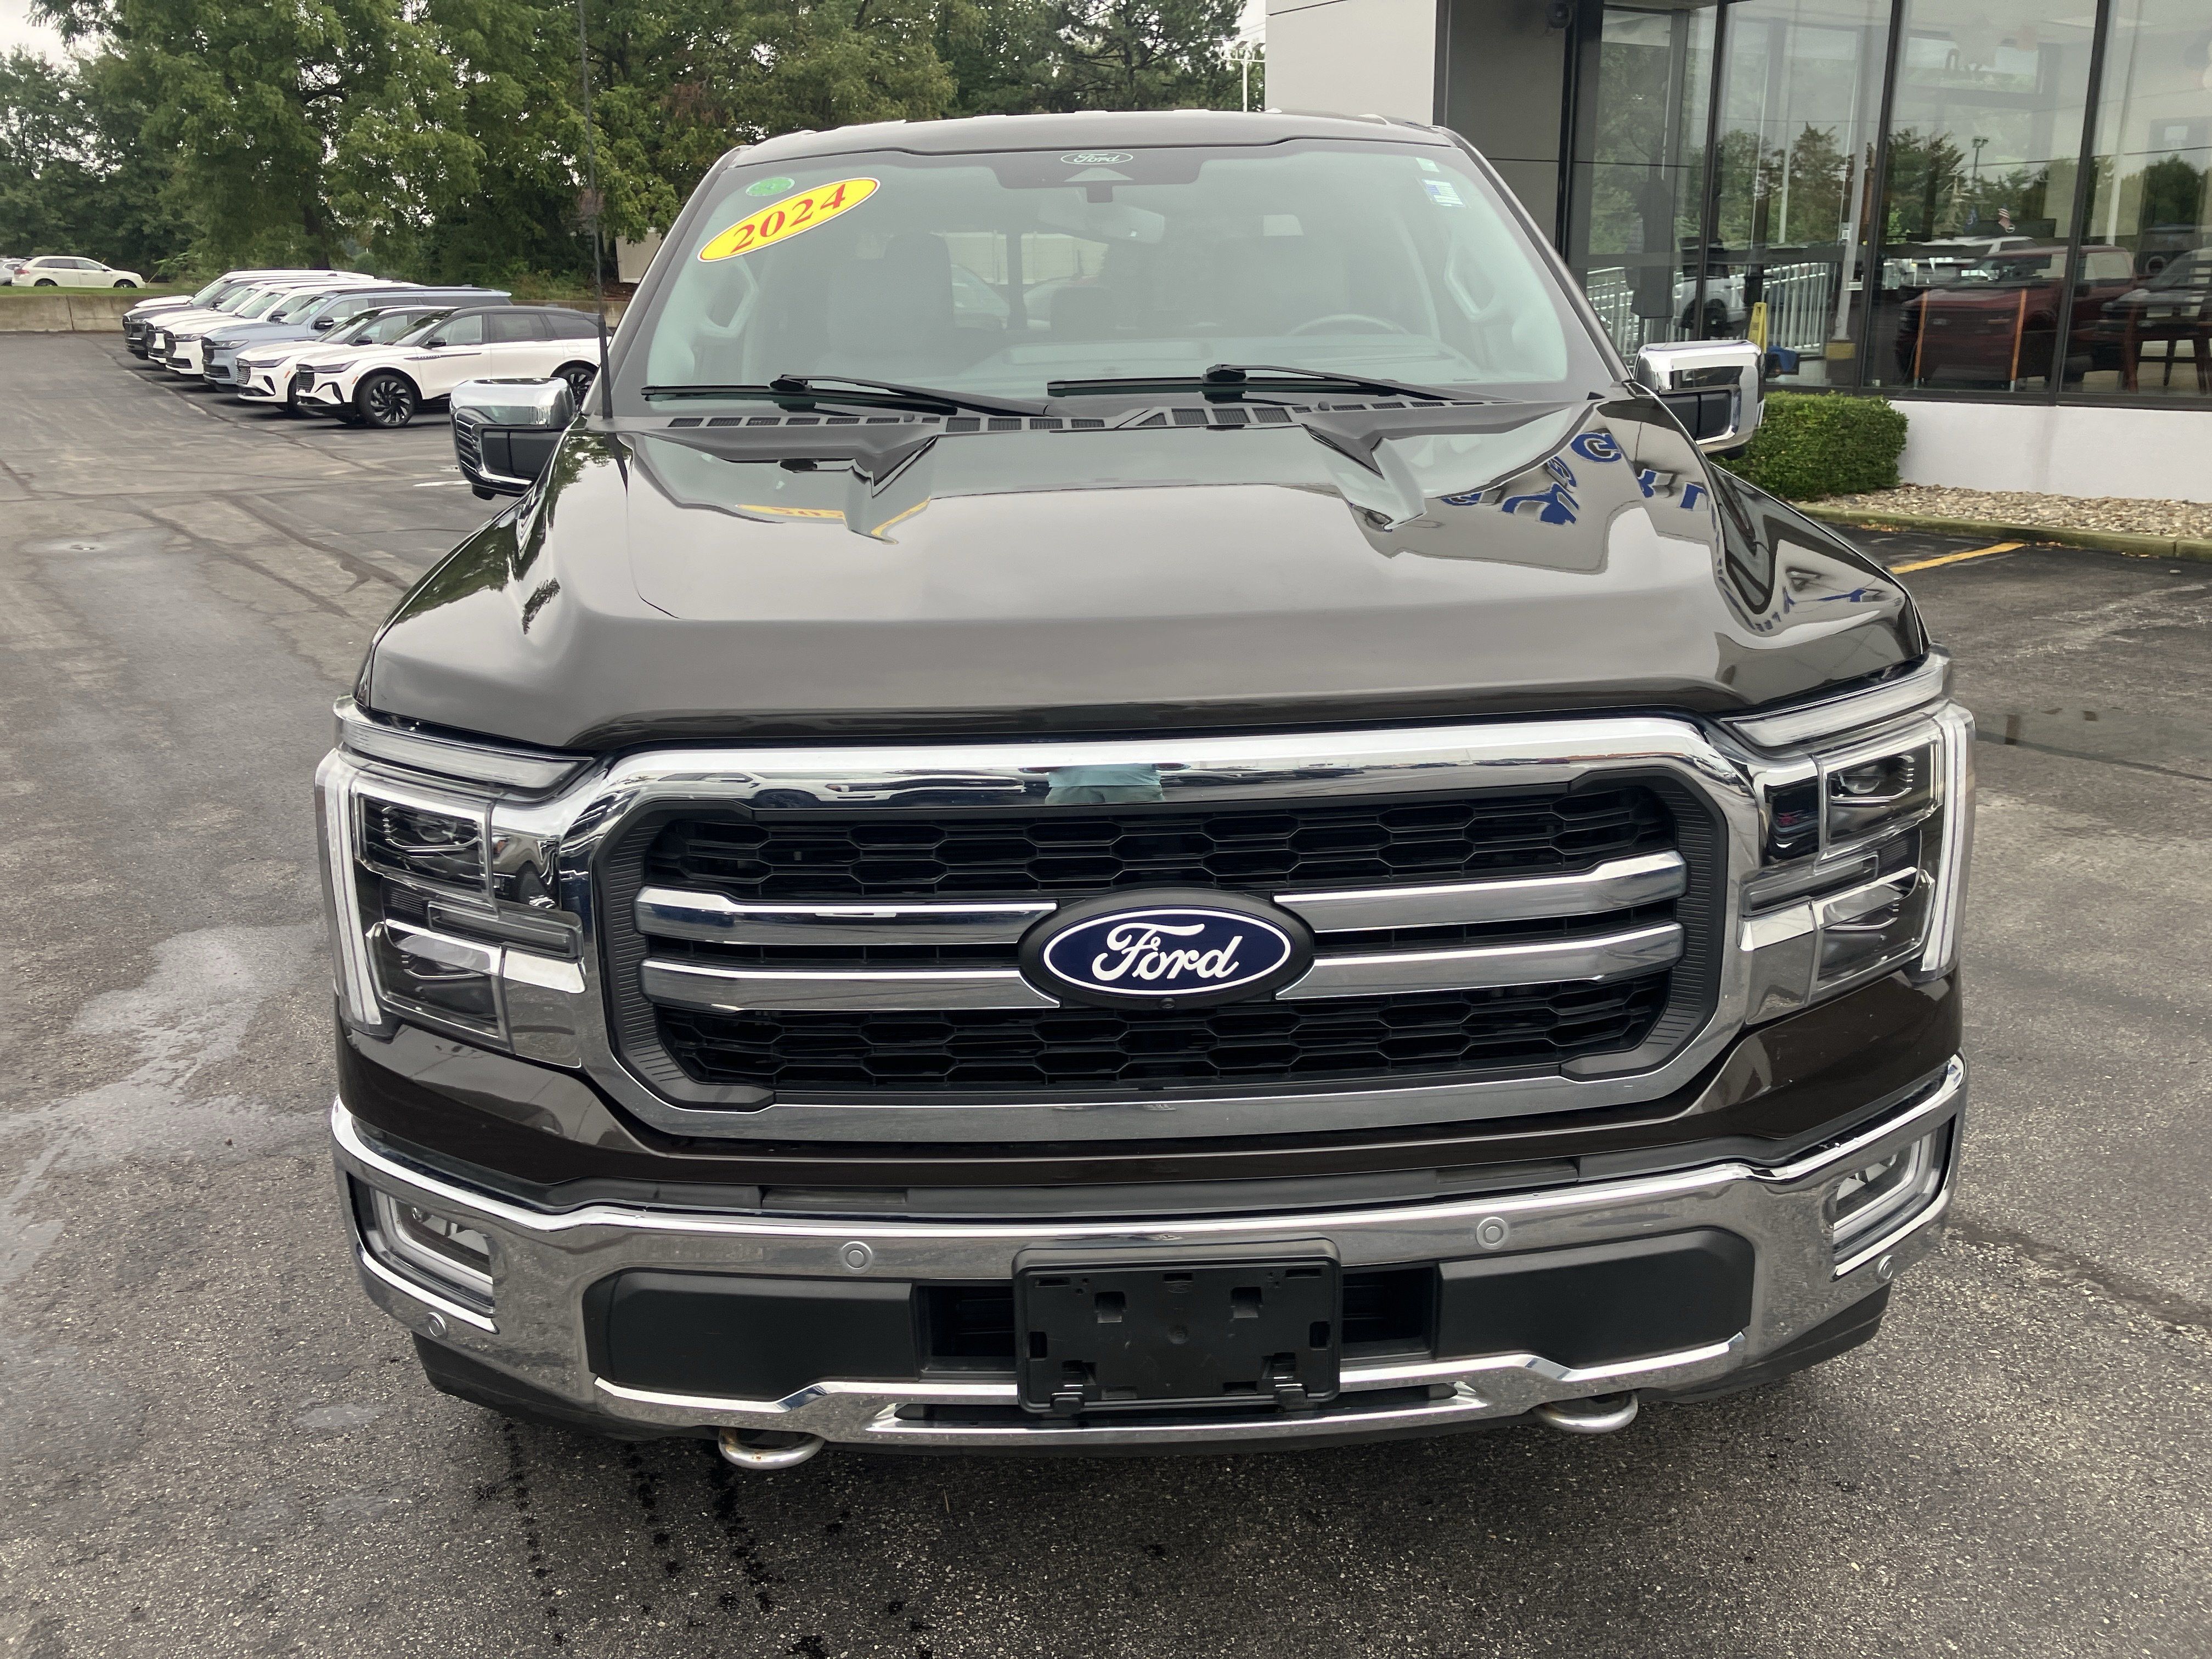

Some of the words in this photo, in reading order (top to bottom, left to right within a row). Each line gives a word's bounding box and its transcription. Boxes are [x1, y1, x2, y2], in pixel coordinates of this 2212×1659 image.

[1074, 153, 1120, 163] Ford
[730, 183, 846, 253] 2024
[1092, 922, 1243, 981] Ford
